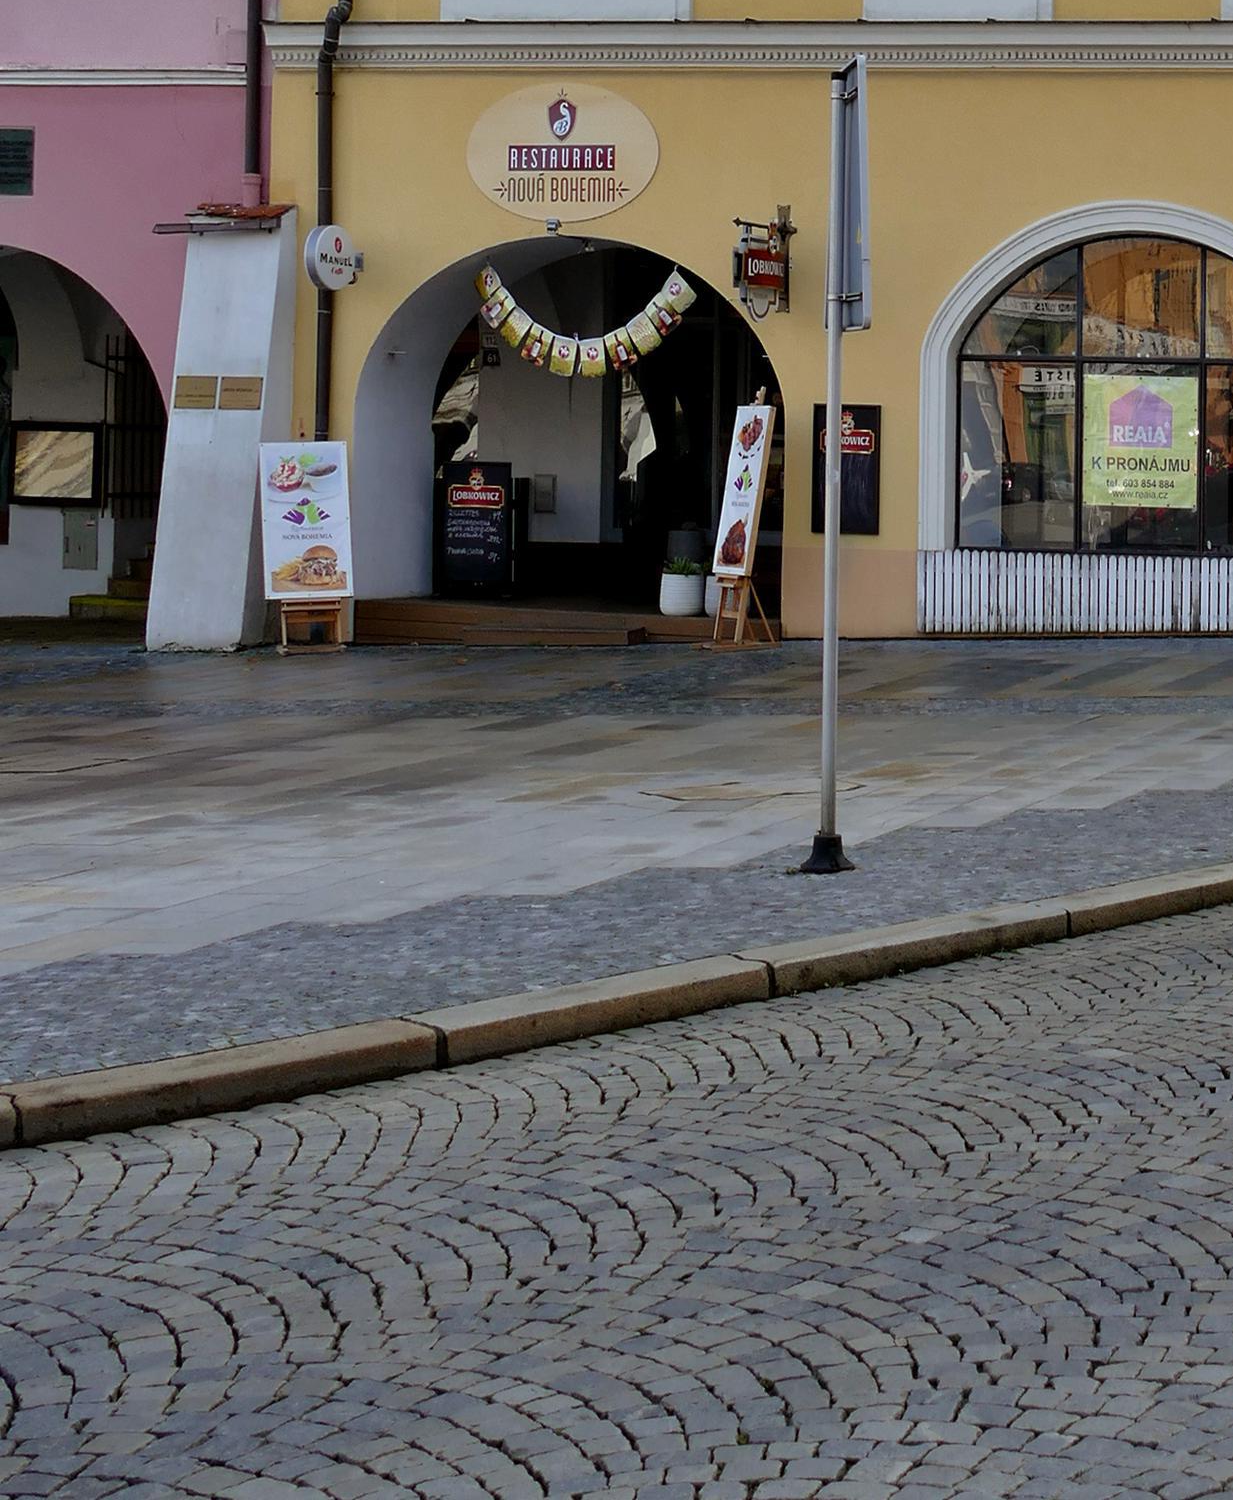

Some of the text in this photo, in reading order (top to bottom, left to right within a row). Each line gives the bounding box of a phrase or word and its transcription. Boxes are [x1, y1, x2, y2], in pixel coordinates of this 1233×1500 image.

[510, 147, 614, 169] RESTAURACE
[507, 173, 616, 202] NOVÁ BOHEMIA
[1091, 455, 1191, 473] K PRONÁJMU
[1122, 478, 1139, 489] 603
[1141, 479, 1157, 489] 854
[1158, 479, 1175, 490] 884
[452, 490, 501, 501] LOBKOWICZ
